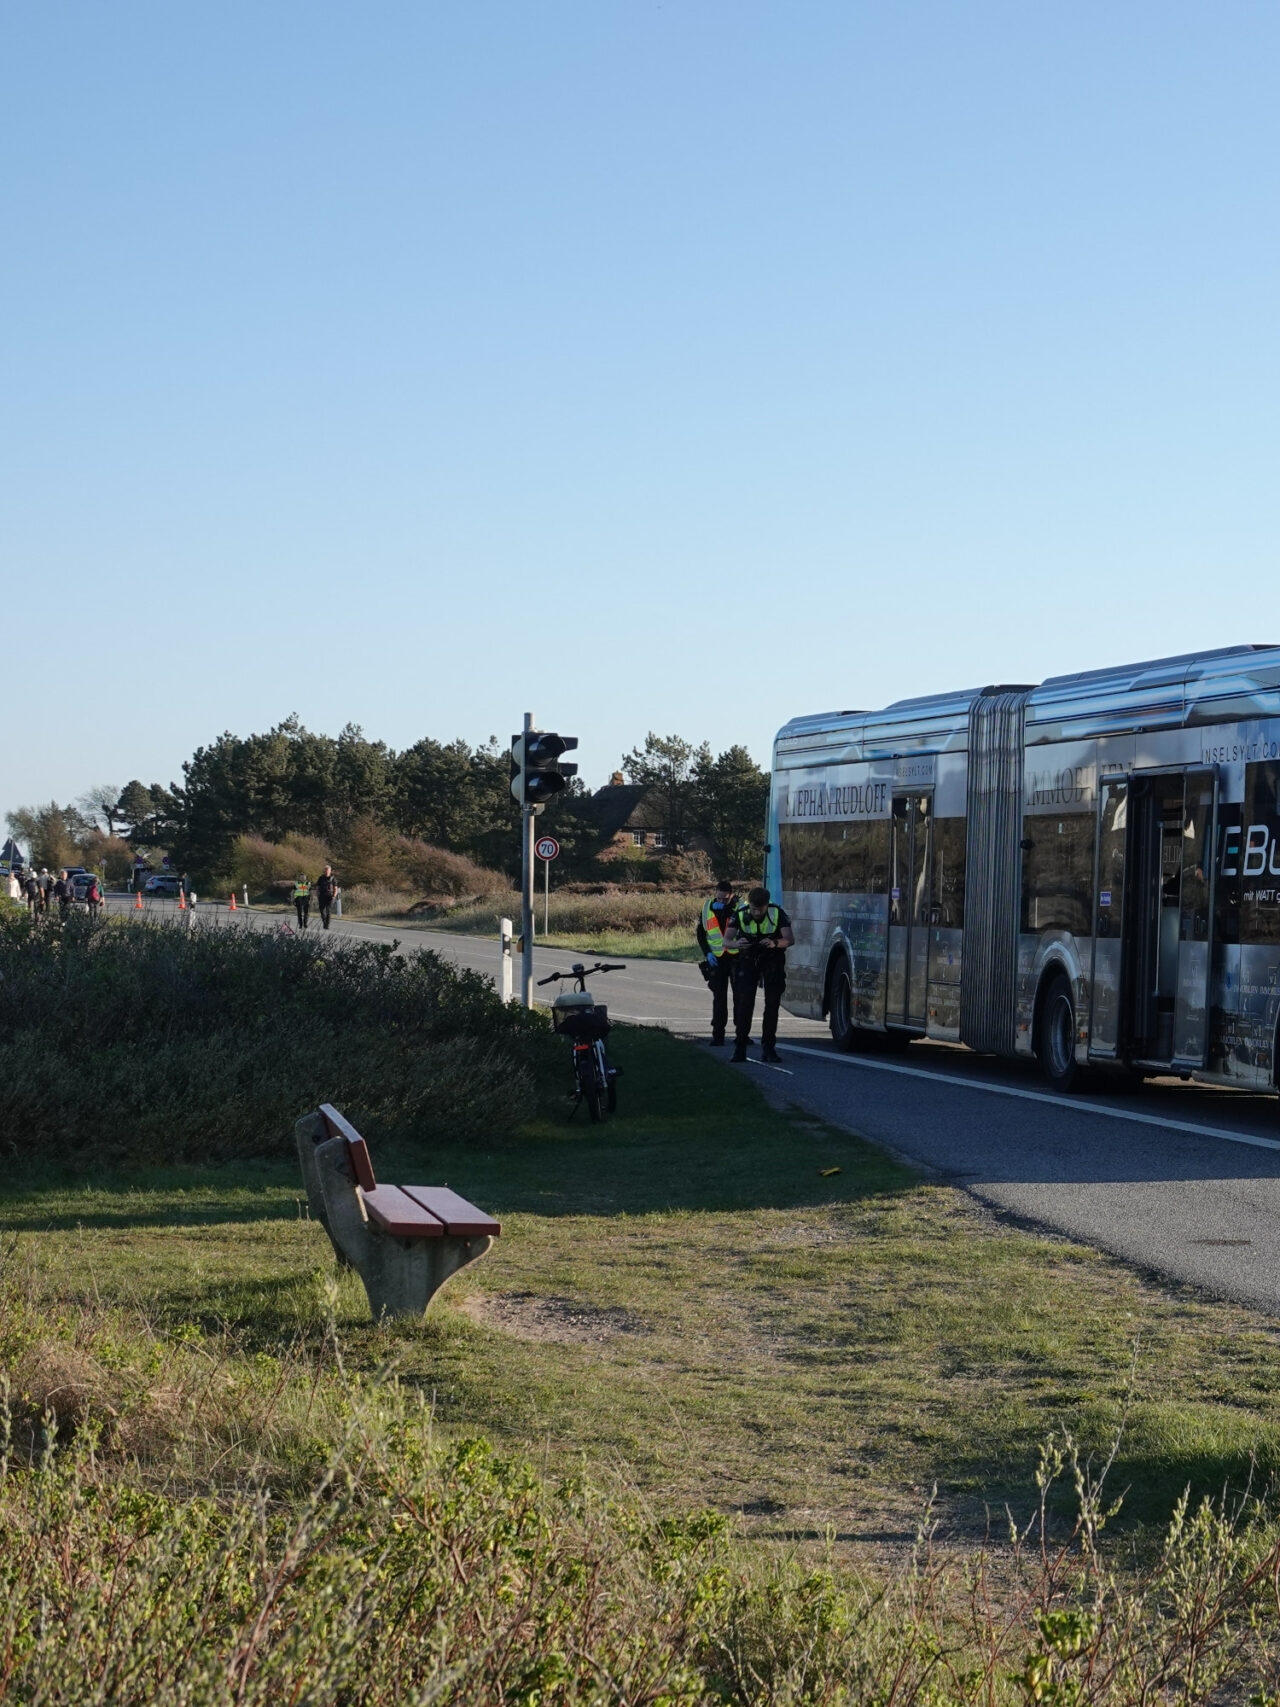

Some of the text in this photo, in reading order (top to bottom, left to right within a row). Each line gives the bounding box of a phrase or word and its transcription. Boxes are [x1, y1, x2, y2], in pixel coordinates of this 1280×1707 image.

[785, 783, 887, 818] STEPHAN RUDLOFF
[541, 843, 554, 855] 70
[1243, 891, 1254, 901] mit
[1256, 890, 1275, 901] WATT
